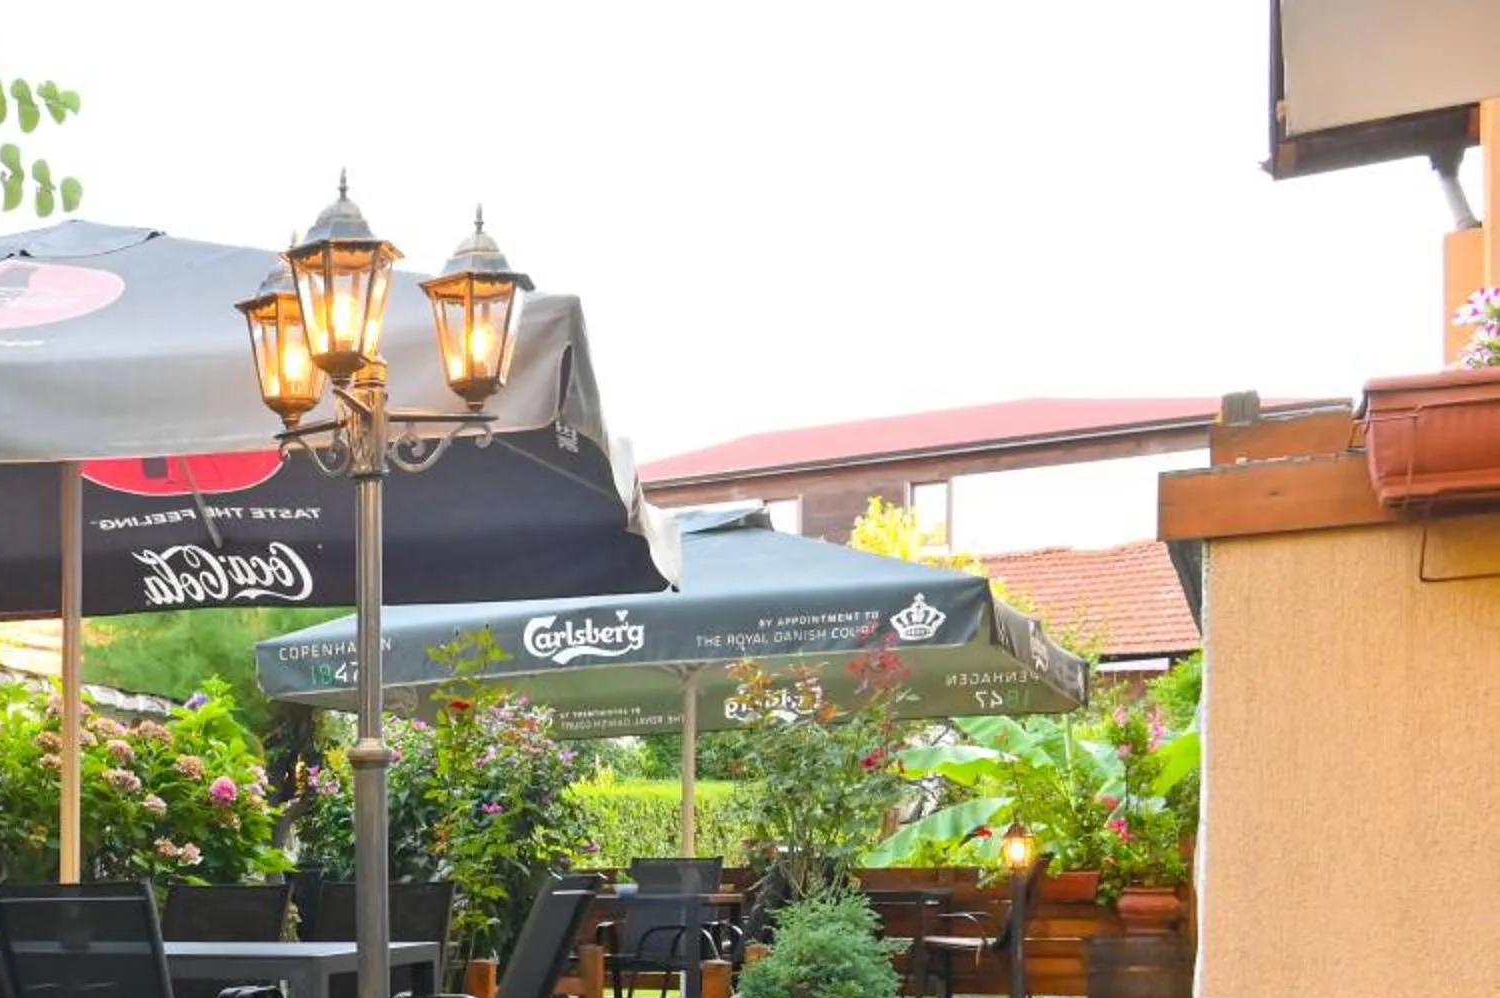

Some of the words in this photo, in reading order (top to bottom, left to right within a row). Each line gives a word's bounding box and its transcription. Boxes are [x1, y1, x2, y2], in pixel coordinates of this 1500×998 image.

[758, 618, 773, 629] BY
[777, 611, 861, 627] APPOINTMENT
[523, 609, 645, 665] Carlsberg
[696, 634, 723, 648] THE
[727, 632, 769, 647] ROYAL
[773, 628, 828, 643] DANISH
[278, 637, 393, 662] COPENHAN
